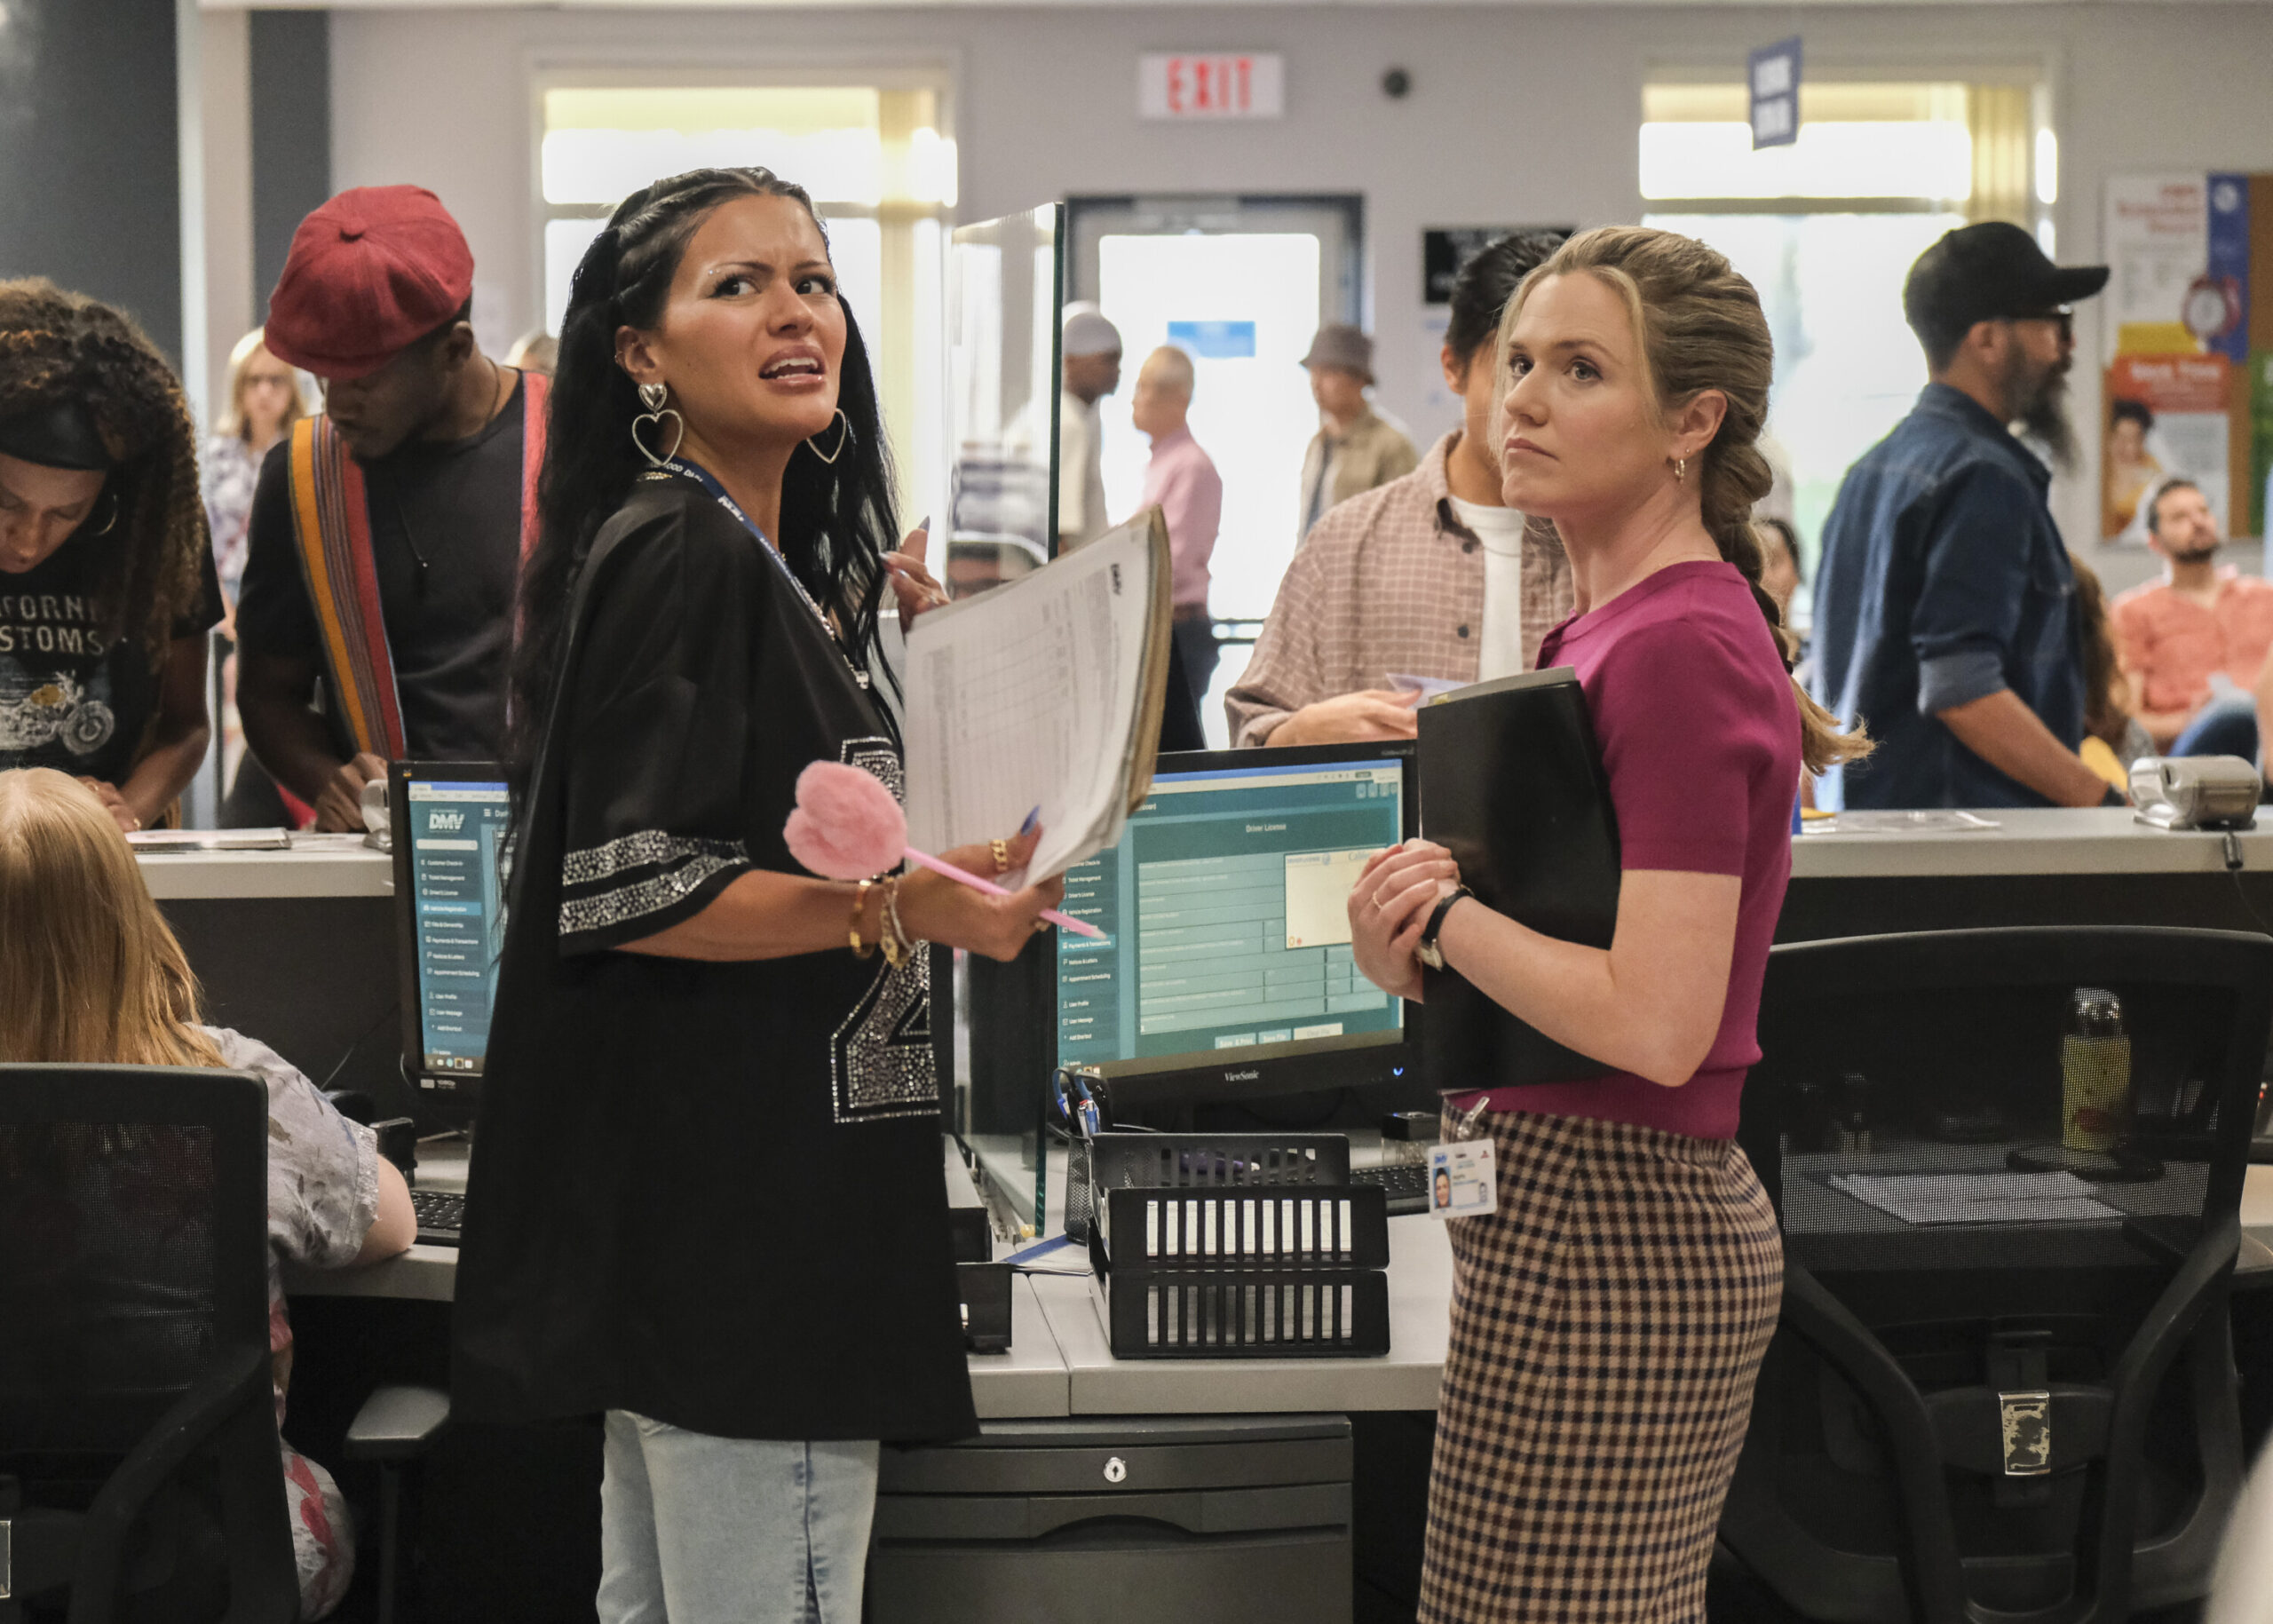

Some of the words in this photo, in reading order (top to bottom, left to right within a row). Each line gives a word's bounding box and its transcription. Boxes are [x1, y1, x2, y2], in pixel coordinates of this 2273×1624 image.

[1167, 57, 1255, 113] EXIT
[429, 812, 464, 830] DMV
[1246, 824, 1263, 833] Driver
[1264, 823, 1287, 832] License
[1224, 1069, 1260, 1081] ViewSonic
